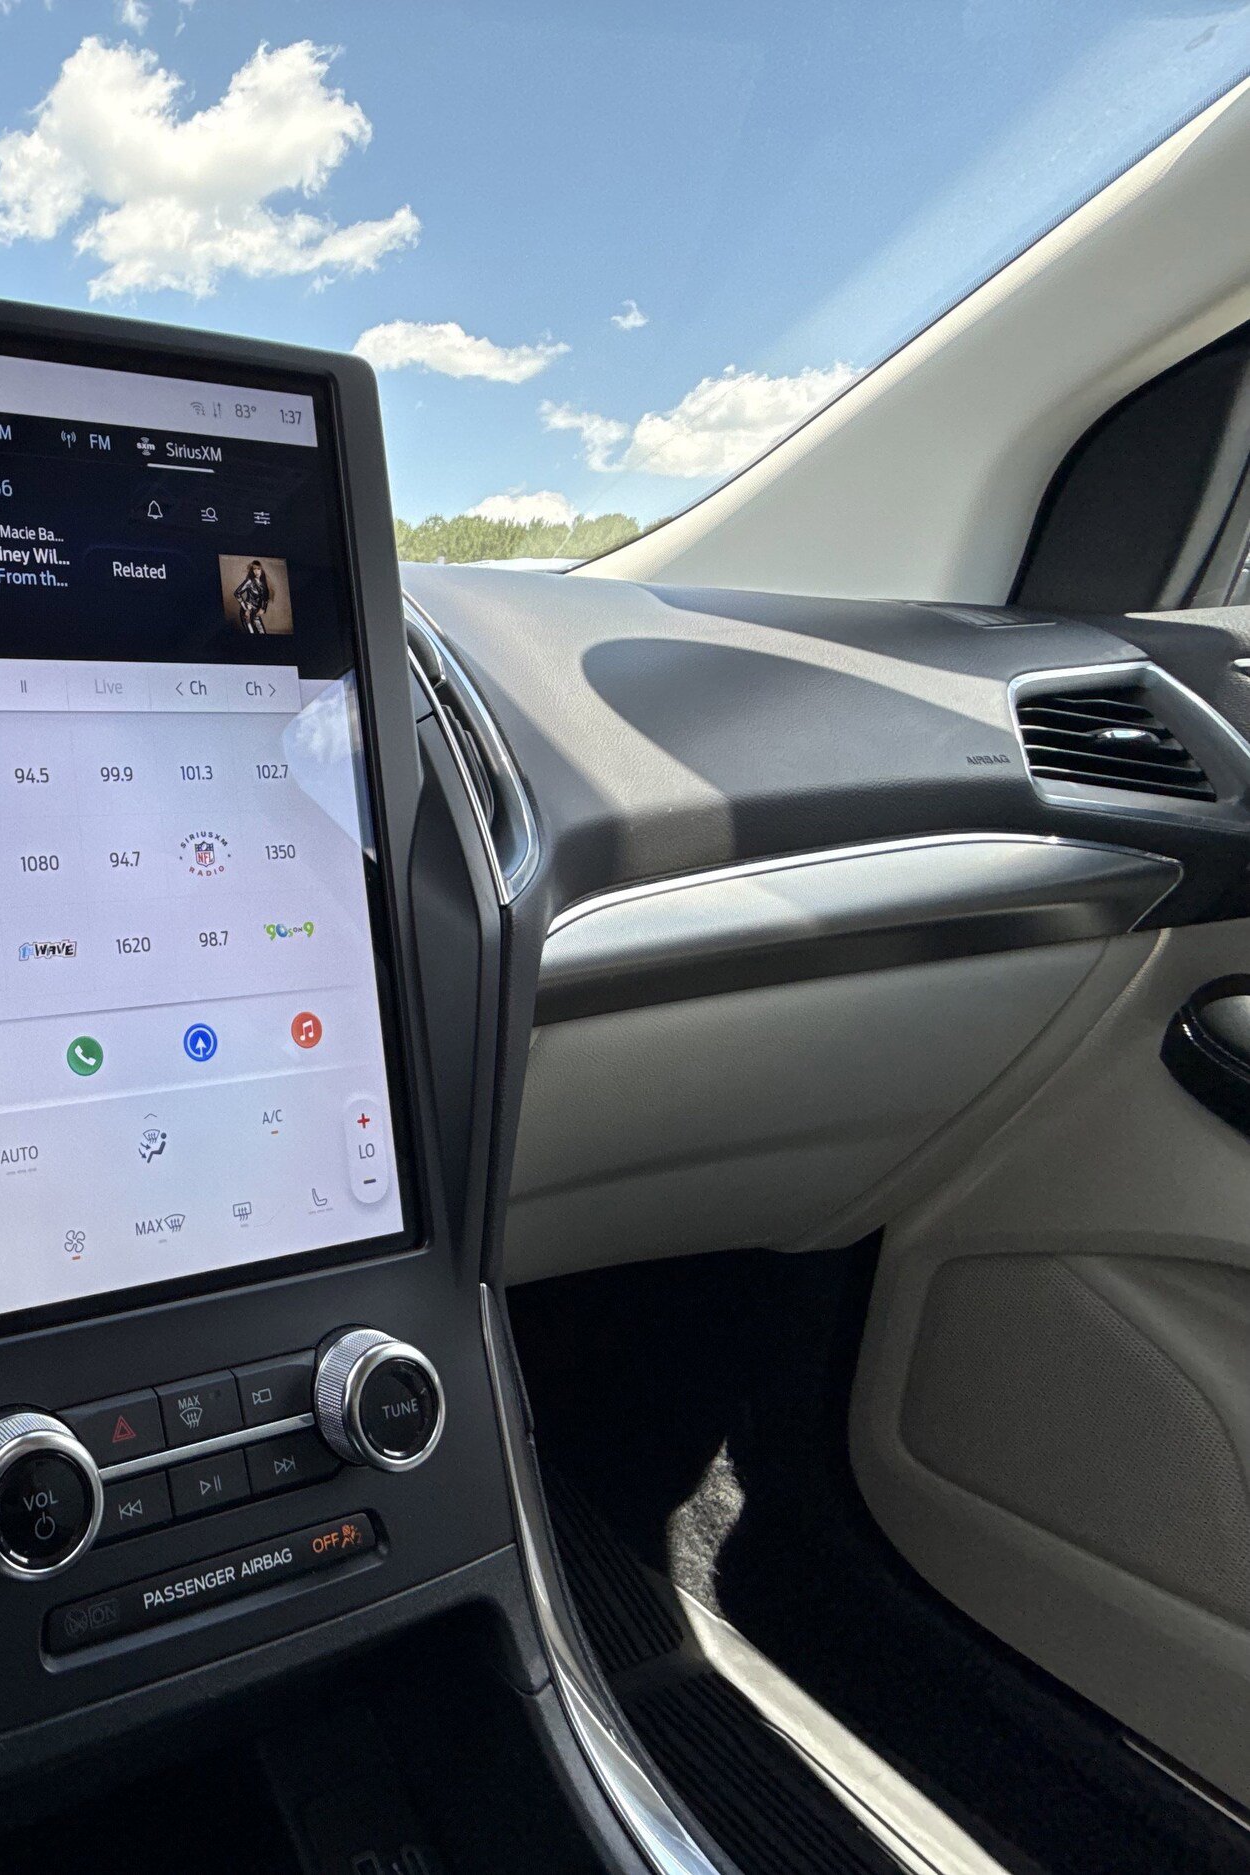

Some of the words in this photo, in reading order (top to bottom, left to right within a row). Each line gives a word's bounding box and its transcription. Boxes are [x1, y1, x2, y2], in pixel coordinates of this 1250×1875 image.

[234, 403, 257, 419] 83°
[279, 409, 302, 425] 1:37
[89, 433, 112, 451] FM
[165, 441, 223, 462] SiriusXM
[0, 524, 37, 541] Macie
[112, 561, 167, 581] Related
[94, 679, 124, 696] Live
[188, 679, 208, 697] Ch
[244, 680, 263, 697] Ch
[965, 754, 1011, 766] AIRBAG
[13, 767, 50, 785] 94.5
[99, 766, 134, 783] 99.9
[179, 765, 214, 781] 101.3
[255, 764, 289, 780] 102.7
[180, 831, 229, 849] SIRIUSXM
[108, 851, 141, 868] 94.7
[196, 851, 214, 864] NFL
[264, 843, 297, 861] 1350
[19, 854, 60, 873] 1080
[188, 865, 225, 877] RADIO
[115, 936, 151, 954] 1620
[198, 930, 229, 948] 98.7
[34, 942, 75, 958] WAVE
[261, 1108, 284, 1125] A/C
[0, 1145, 40, 1165] AUTO
[357, 1142, 376, 1161] LO
[135, 1217, 165, 1237] MAX
[177, 1394, 201, 1410] MAX
[381, 1398, 419, 1419] TUNE
[22, 1490, 59, 1512] VOL
[311, 1532, 340, 1553] OFF
[142, 1566, 237, 1610] PASSENGER
[240, 1547, 293, 1578] AIRBAG
